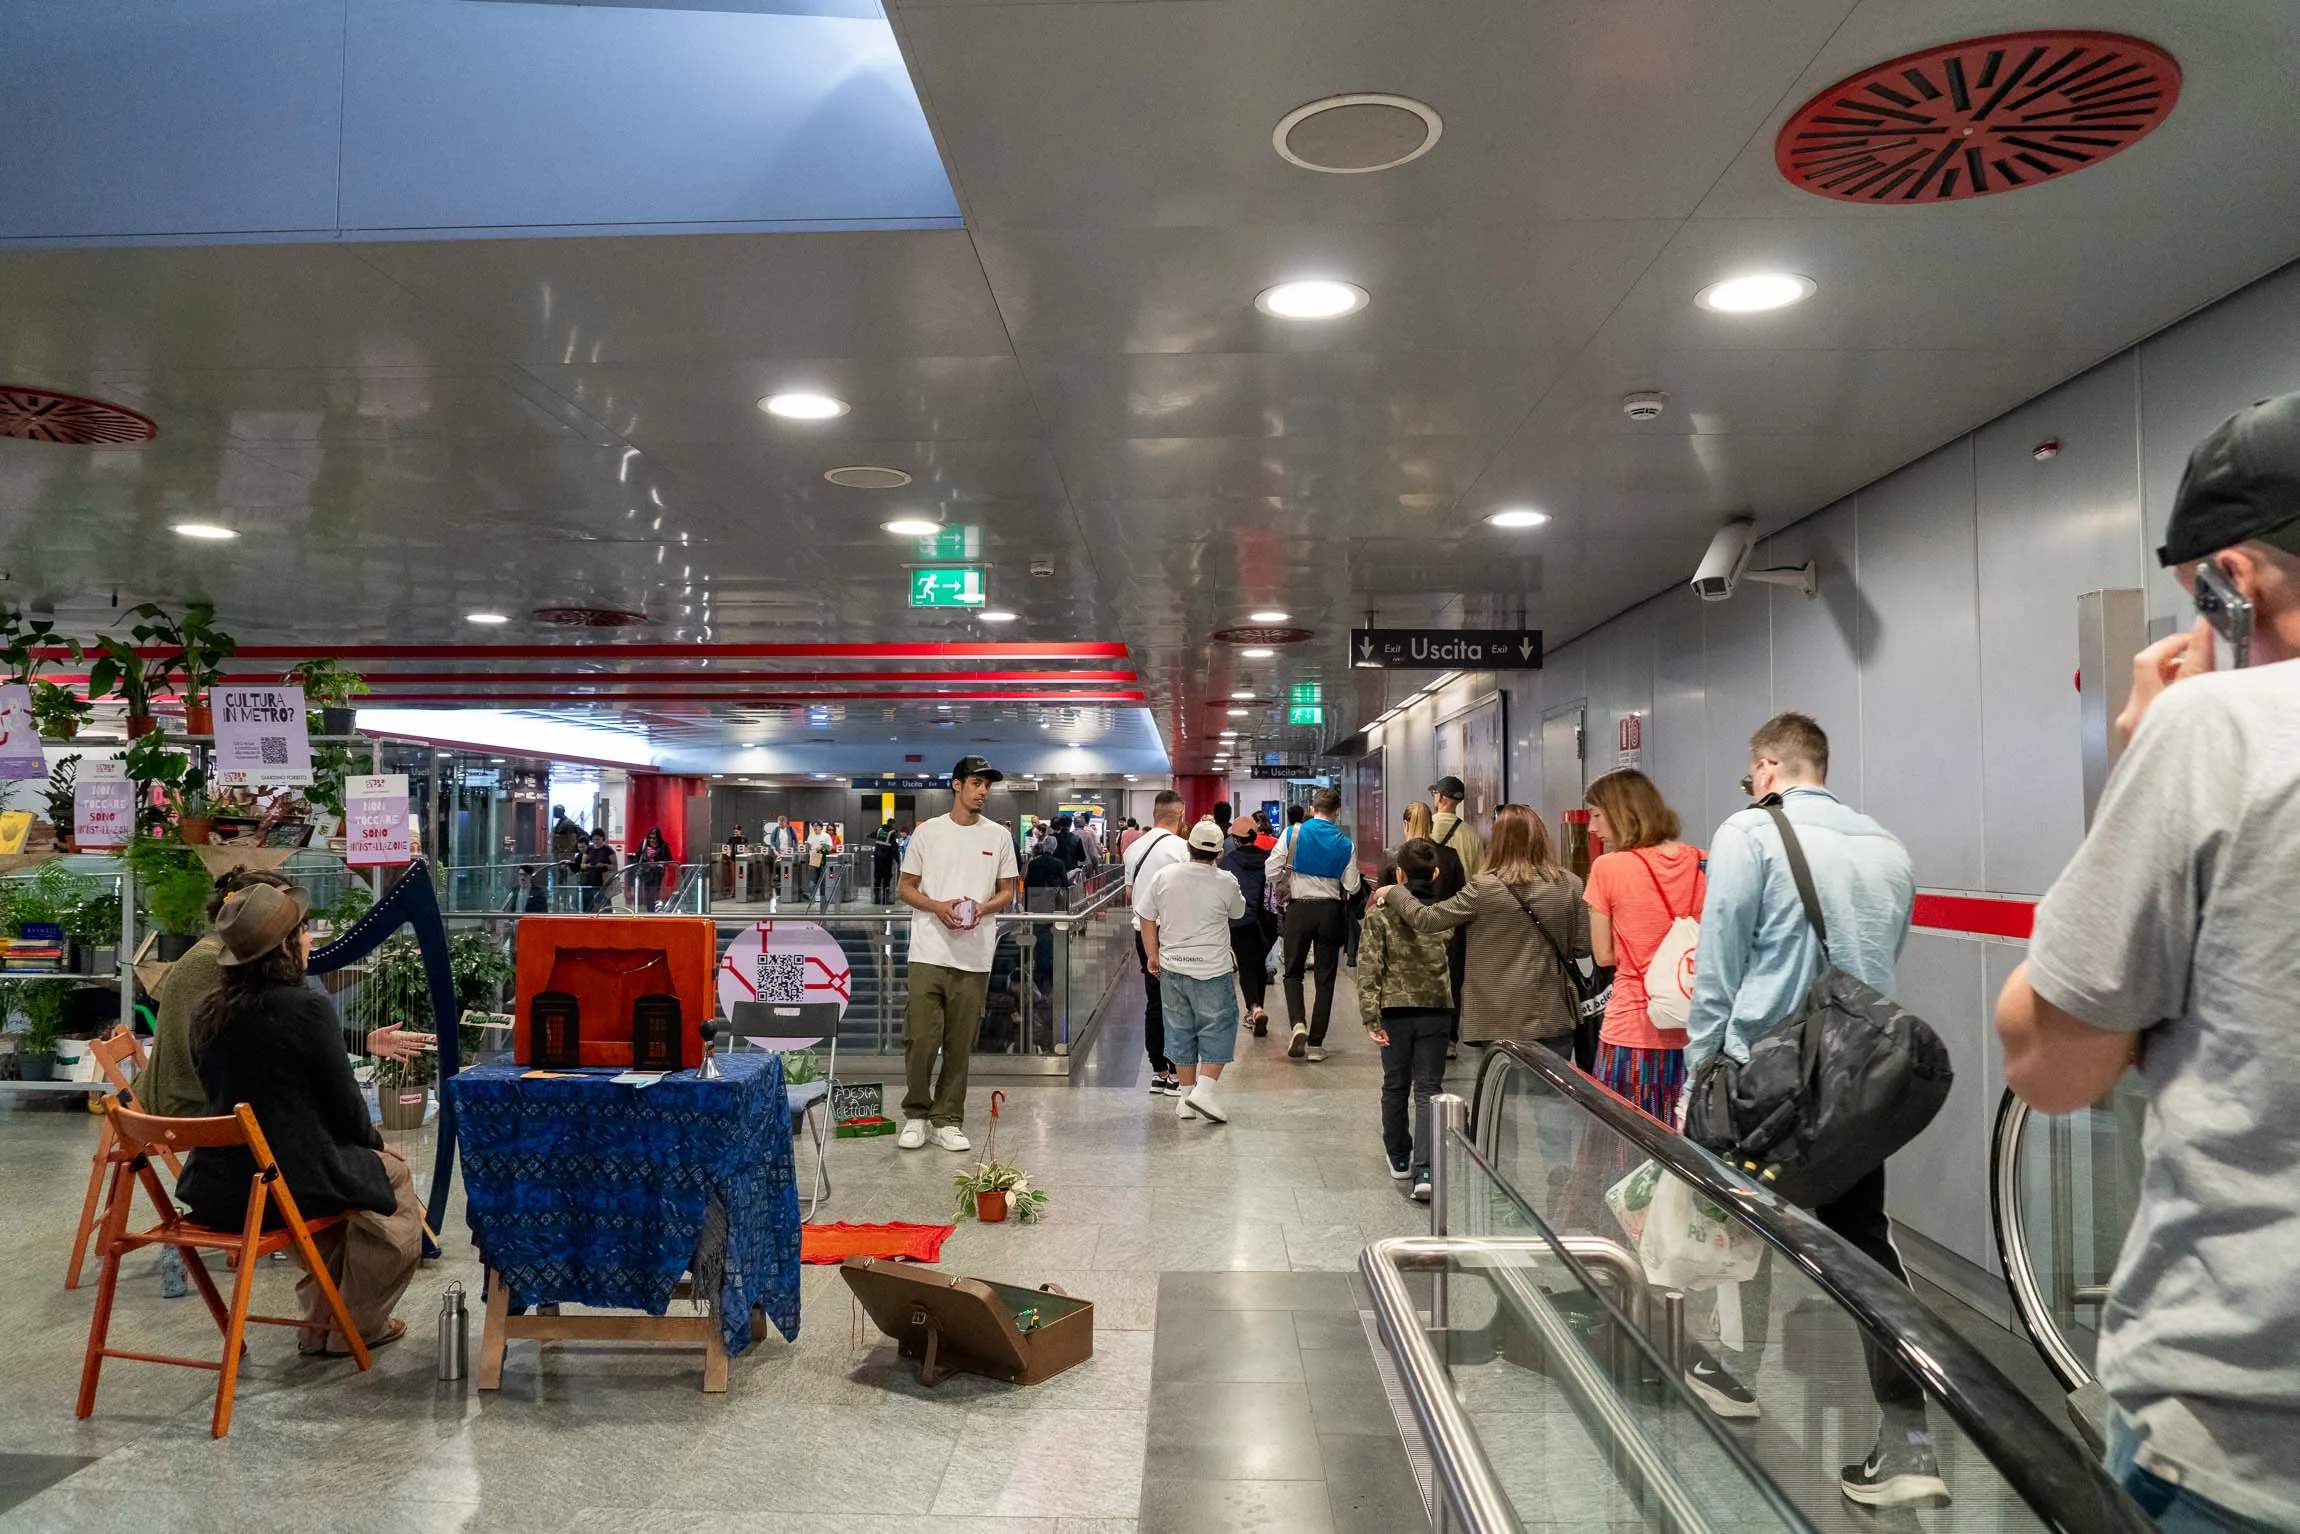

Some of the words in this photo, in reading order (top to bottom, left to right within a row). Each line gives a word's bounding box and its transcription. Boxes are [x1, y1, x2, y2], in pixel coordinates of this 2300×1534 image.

[1384, 643, 1401, 653] Exit
[1411, 638, 1482, 660] Uscita
[1491, 644, 1508, 654] Exit
[225, 693, 286, 708] CULTURA
[223, 708, 237, 722] IN
[241, 707, 295, 722] METRO?
[1270, 768, 1296, 776] Uscita
[902, 780, 923, 788] Uscita
[83, 799, 127, 809] TOCCARE
[89, 812, 115, 822] SONO
[354, 814, 401, 825] TOCCARE
[362, 828, 388, 838] SONO
[834, 1087, 879, 1103] POESIA
[849, 1098, 860, 1107] A
